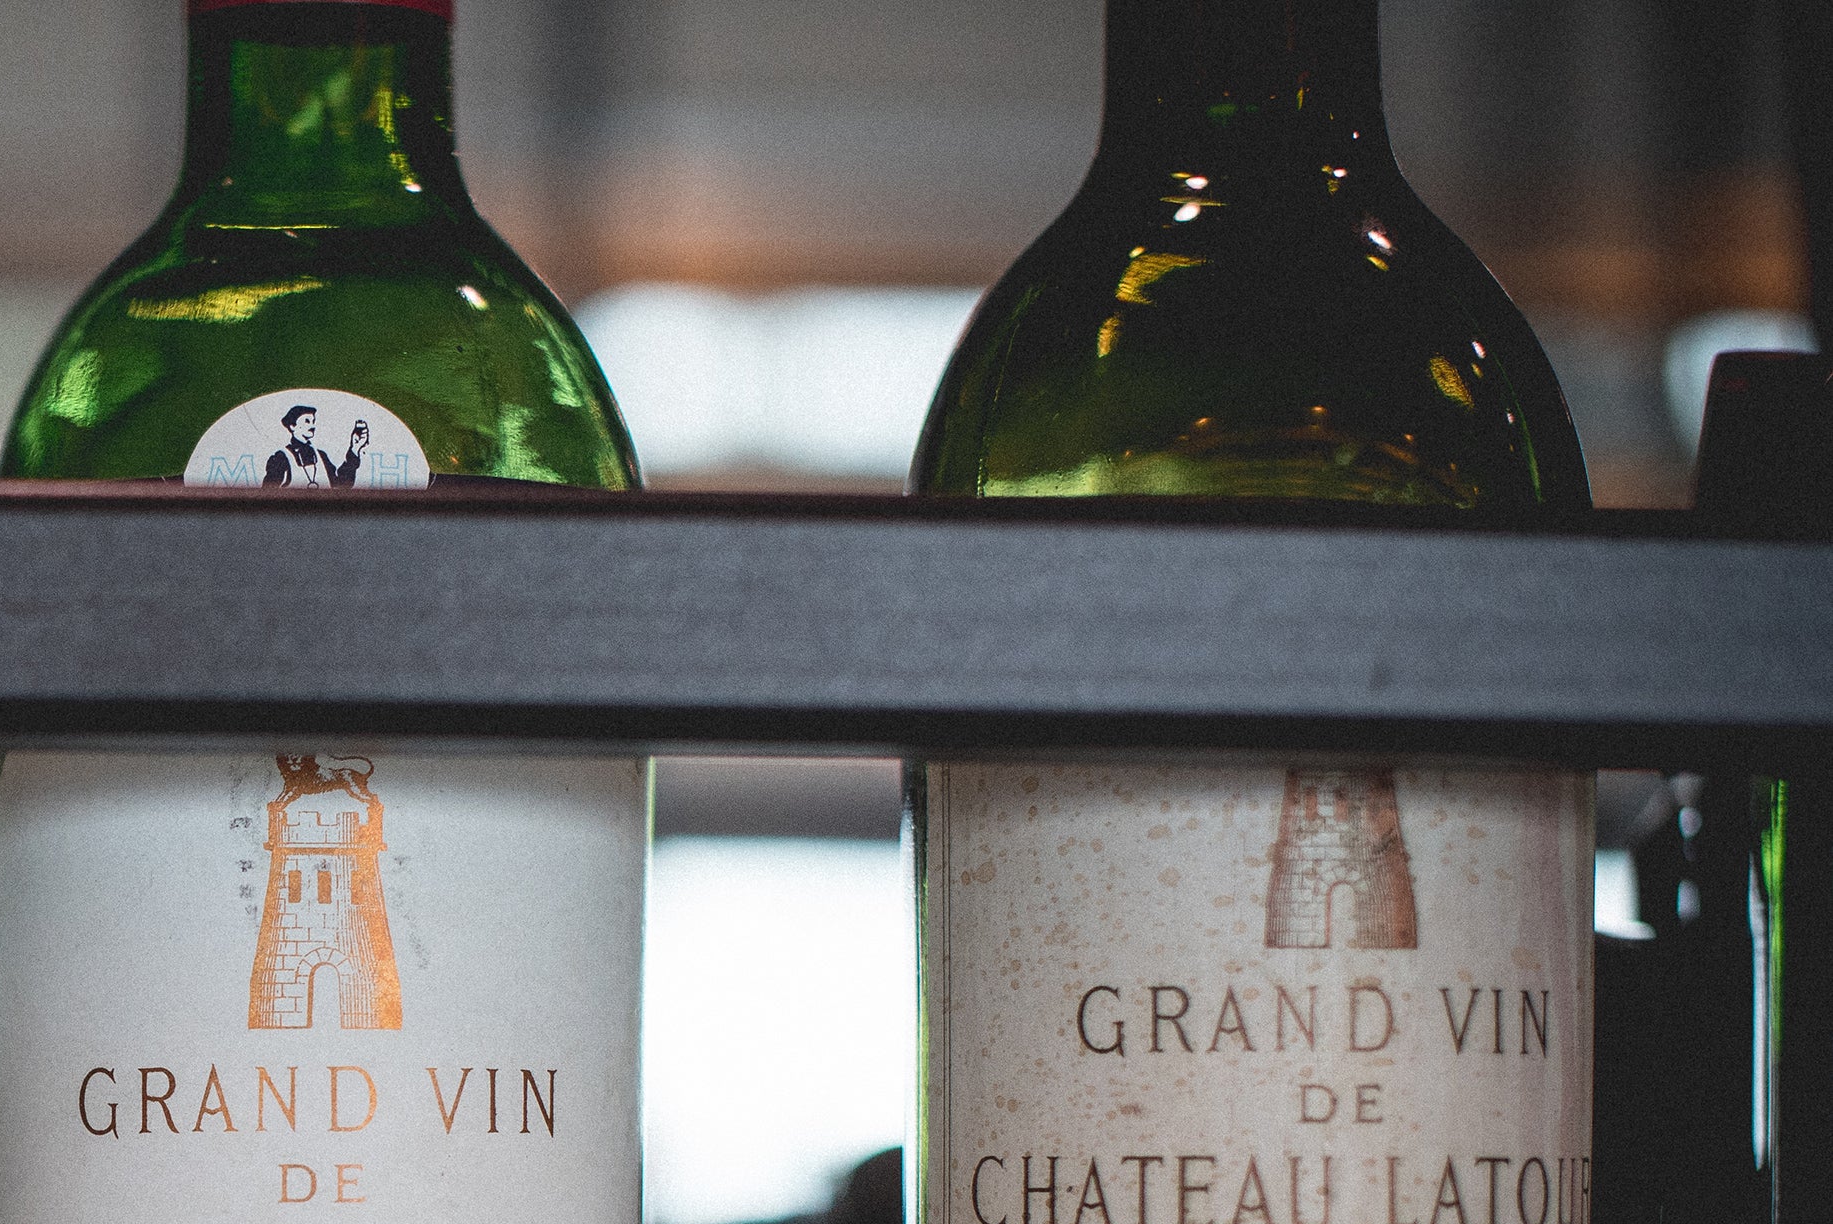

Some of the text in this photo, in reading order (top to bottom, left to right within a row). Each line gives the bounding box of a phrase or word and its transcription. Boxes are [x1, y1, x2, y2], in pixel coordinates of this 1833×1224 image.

[1076, 983, 1551, 1060] GRAND VIN
[78, 1063, 559, 1139] GRAND VIN
[1298, 1083, 1384, 1127] DE
[277, 1163, 367, 1205] DE
